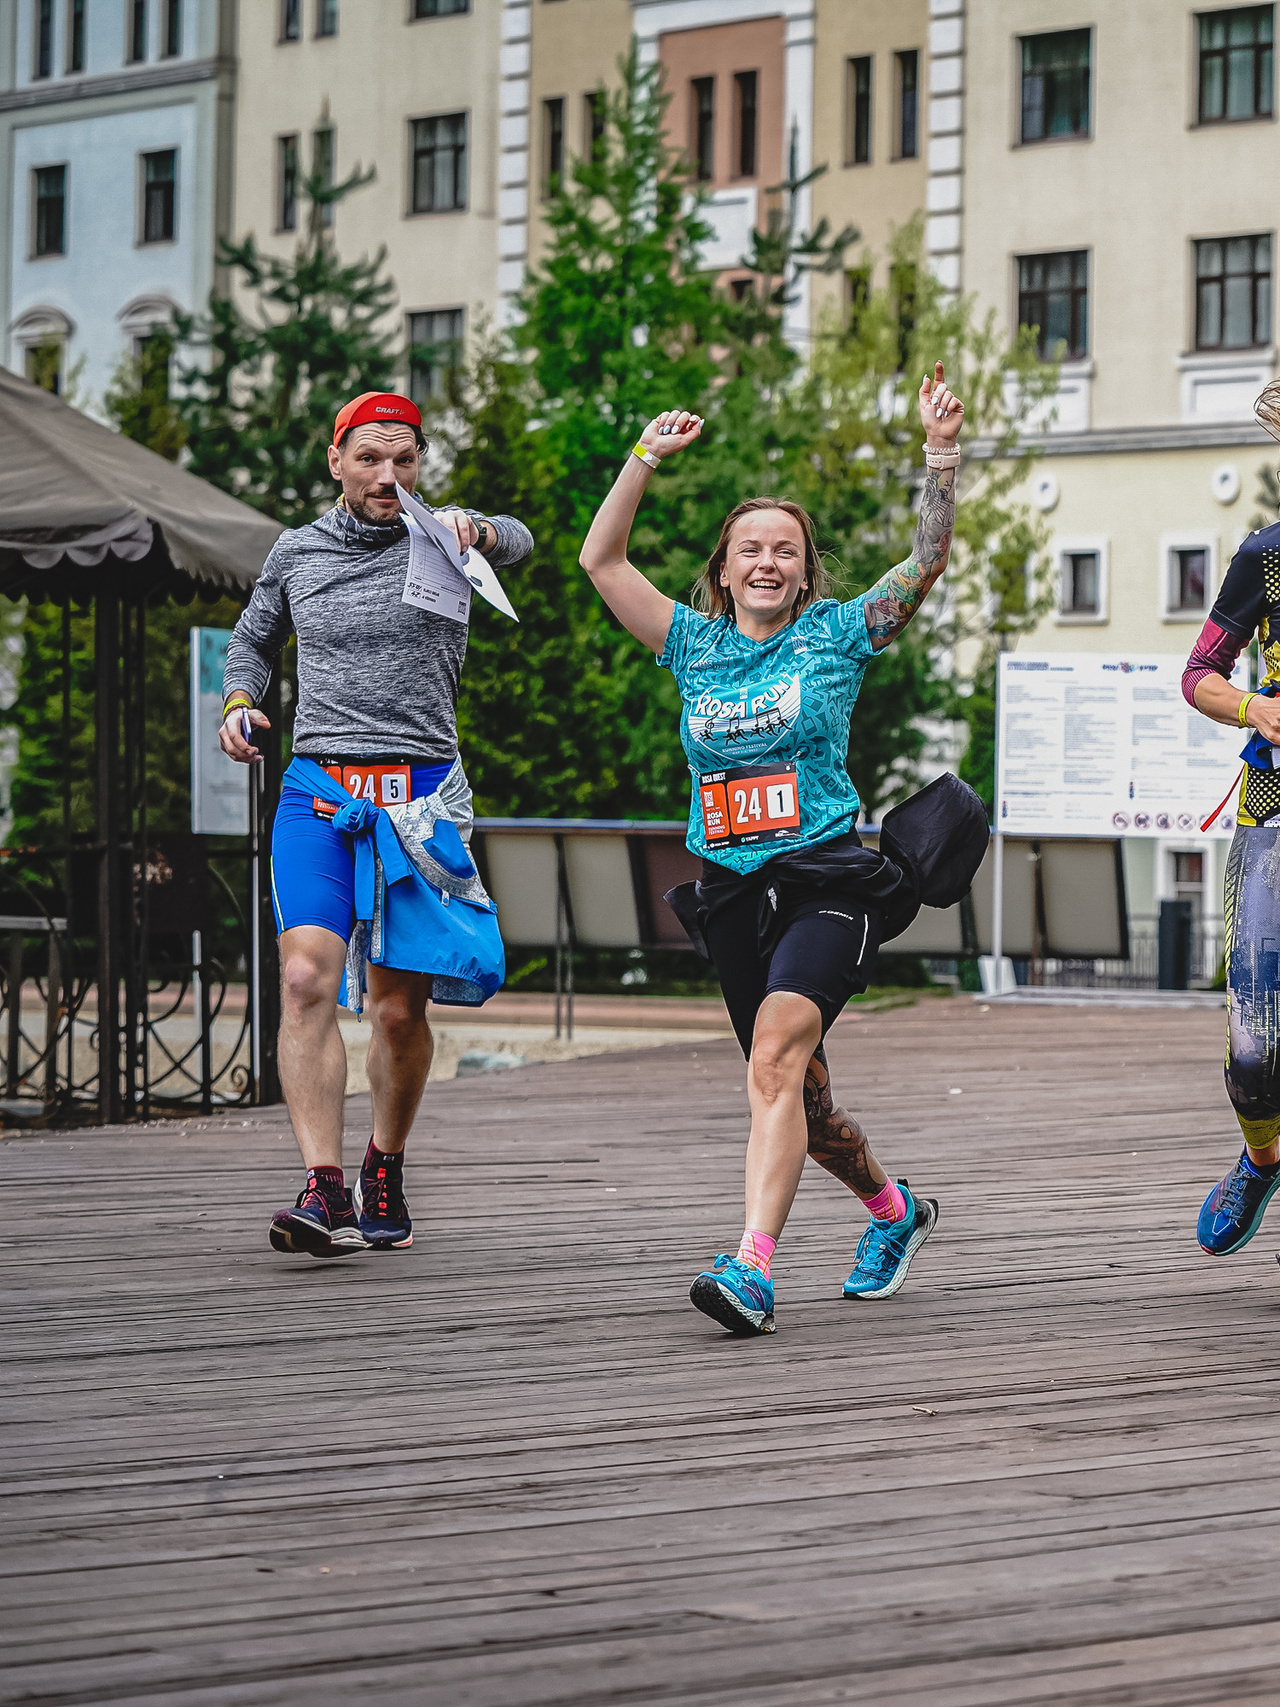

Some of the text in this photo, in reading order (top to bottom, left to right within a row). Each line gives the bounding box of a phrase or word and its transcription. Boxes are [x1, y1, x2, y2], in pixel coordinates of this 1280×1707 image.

[375, 406, 399, 414] CRAFT
[694, 680, 790, 718] ROSA RUN
[702, 772, 726, 784] ROSA QUEST
[350, 774, 398, 804] 24 5
[734, 787, 762, 824] 24
[776, 790, 784, 813] 1
[706, 811, 723, 820] ROSA
[707, 818, 721, 826] RUN
